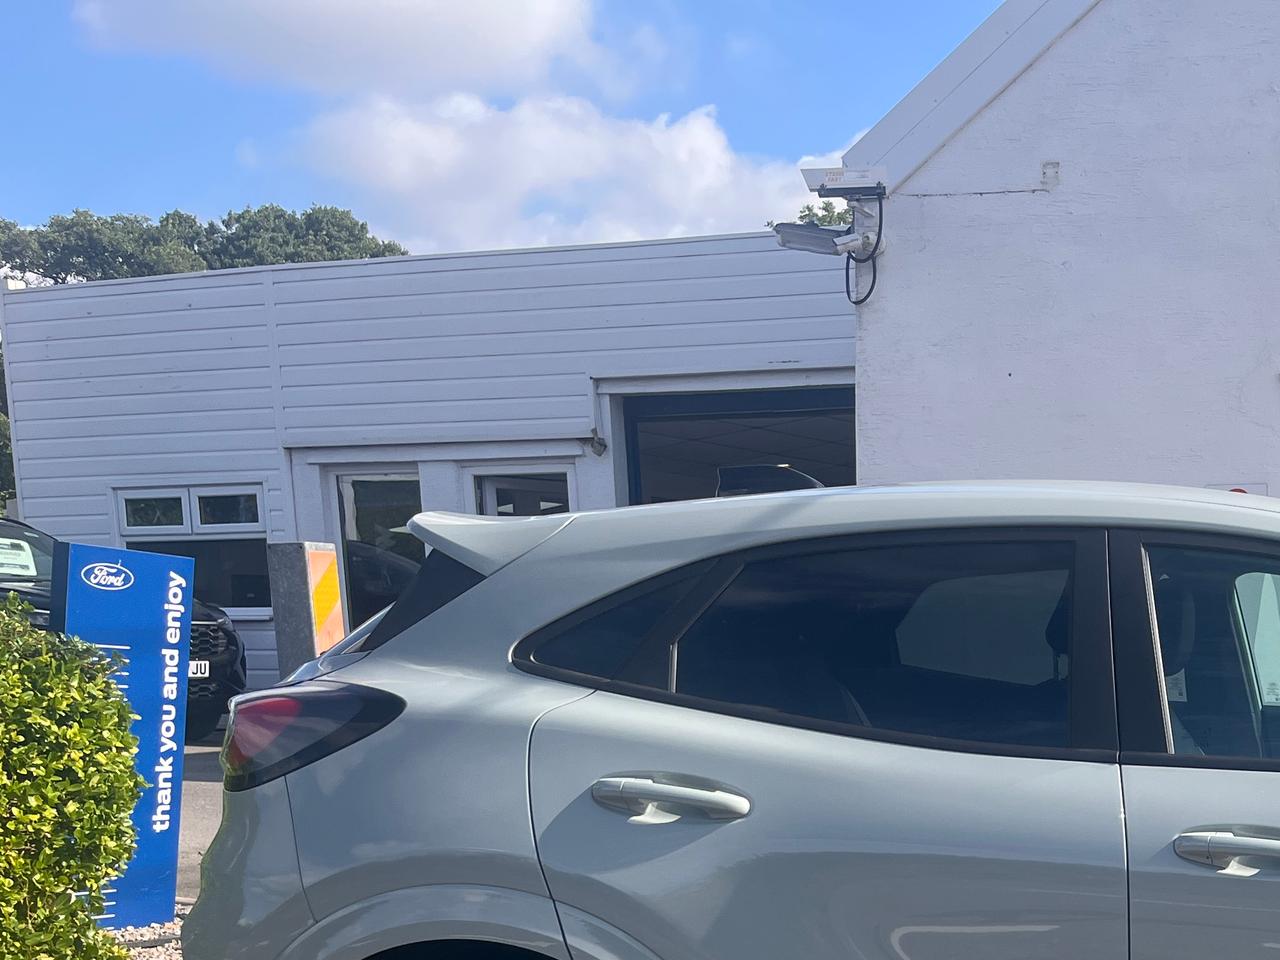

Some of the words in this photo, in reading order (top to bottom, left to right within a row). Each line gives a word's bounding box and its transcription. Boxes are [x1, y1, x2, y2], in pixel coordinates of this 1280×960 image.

[164, 571, 186, 644] enjoy
[162, 648, 179, 700] and
[191, 663, 207, 675] JU
[160, 705, 177, 752] you
[152, 756, 174, 833] thank
